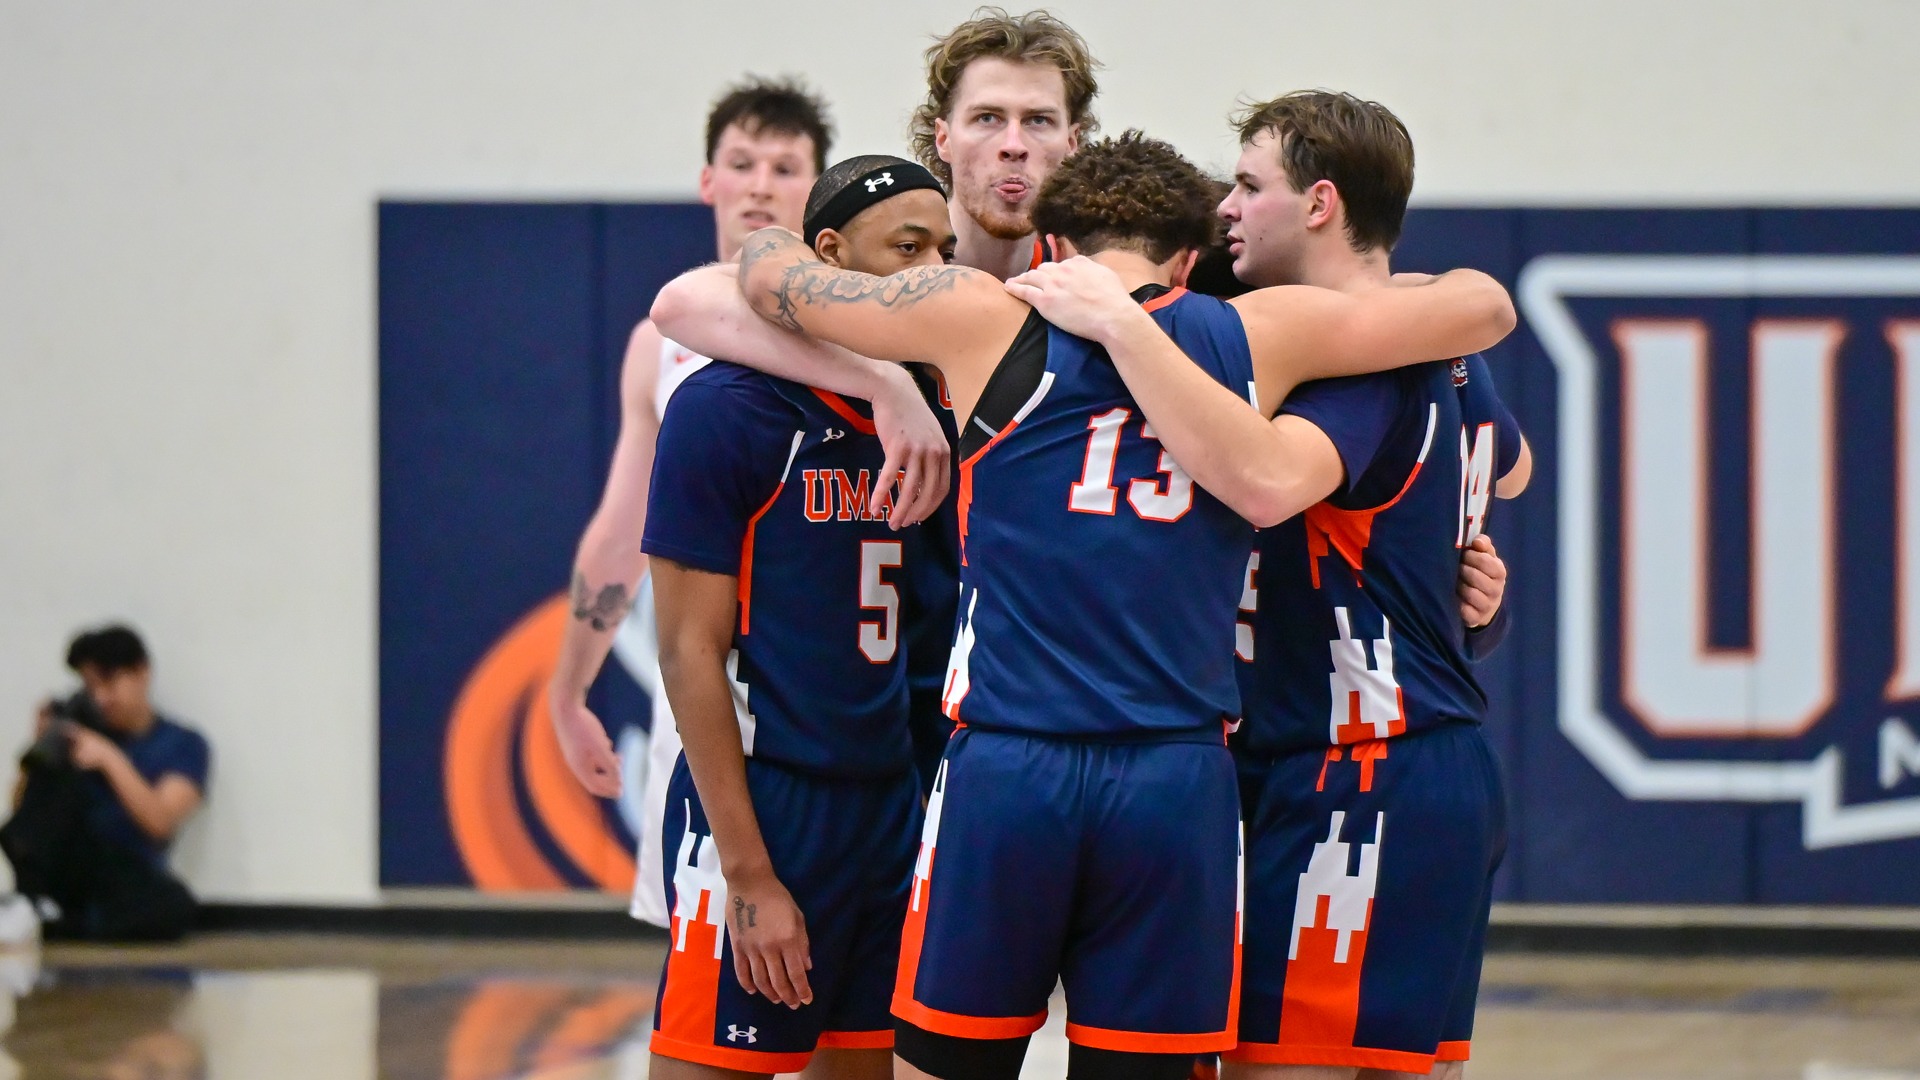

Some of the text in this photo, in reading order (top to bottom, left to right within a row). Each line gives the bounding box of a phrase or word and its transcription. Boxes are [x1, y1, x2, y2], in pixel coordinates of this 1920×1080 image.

[1068, 407, 1194, 523] 13
[1609, 316, 1920, 738] U
[858, 539, 902, 664] 5
